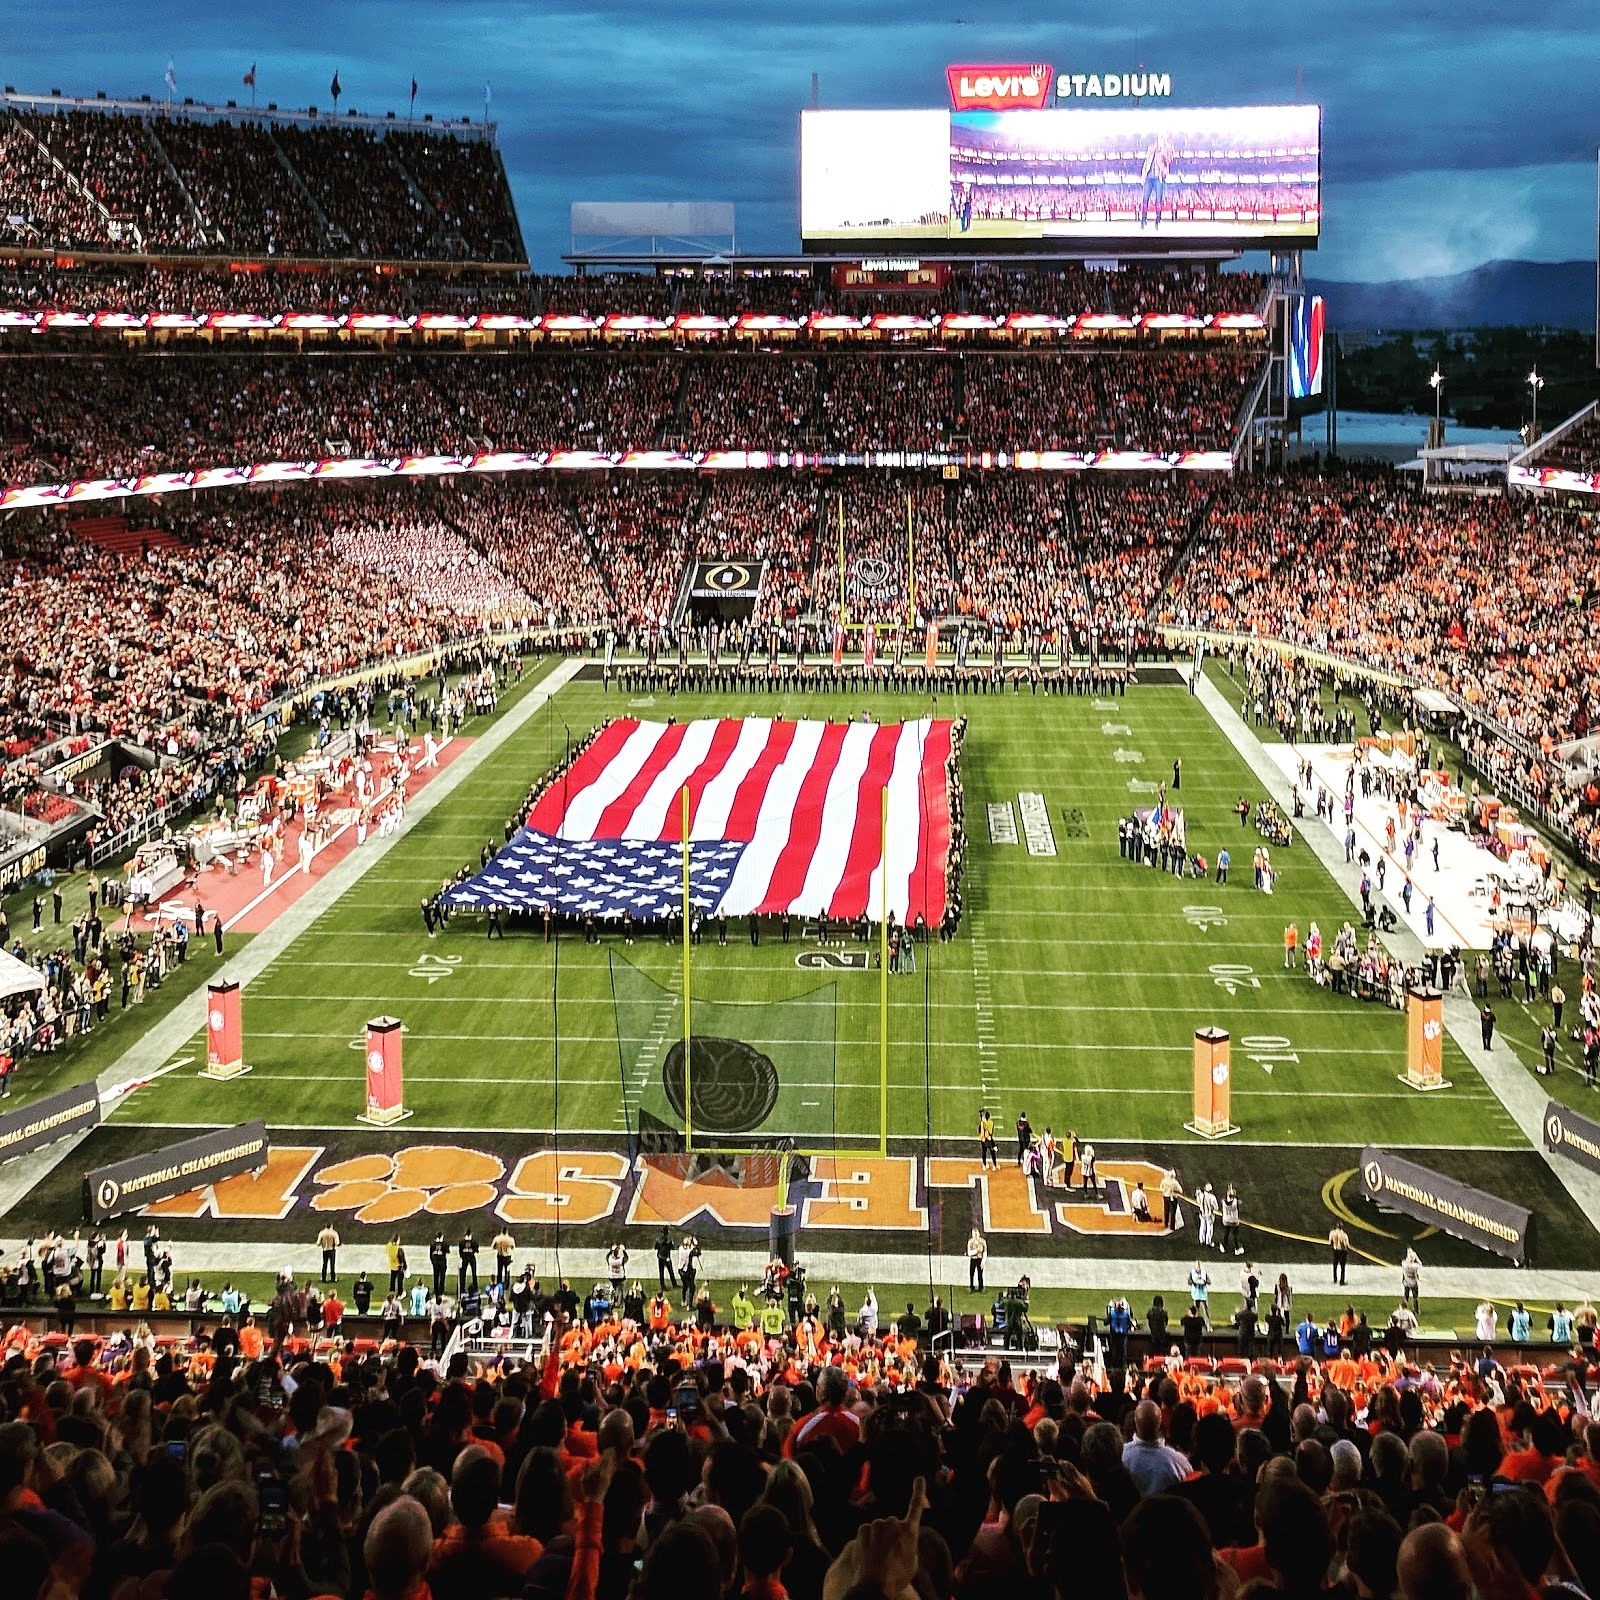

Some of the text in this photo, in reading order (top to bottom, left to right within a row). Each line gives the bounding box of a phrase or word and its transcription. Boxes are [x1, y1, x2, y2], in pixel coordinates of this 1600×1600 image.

[1057, 74, 1171, 97] STADIUM
[846, 580, 898, 600] Allstate
[1209, 963, 1261, 988] 20
[1241, 1035, 1300, 1063] 10
[25, 1100, 96, 1137] CHAMPIONSHIP
[122, 1140, 262, 1194] NATIONAL CHAMPIONSHIP
[1385, 1175, 1520, 1243] NATIONAL CHAMPIONSHIP
